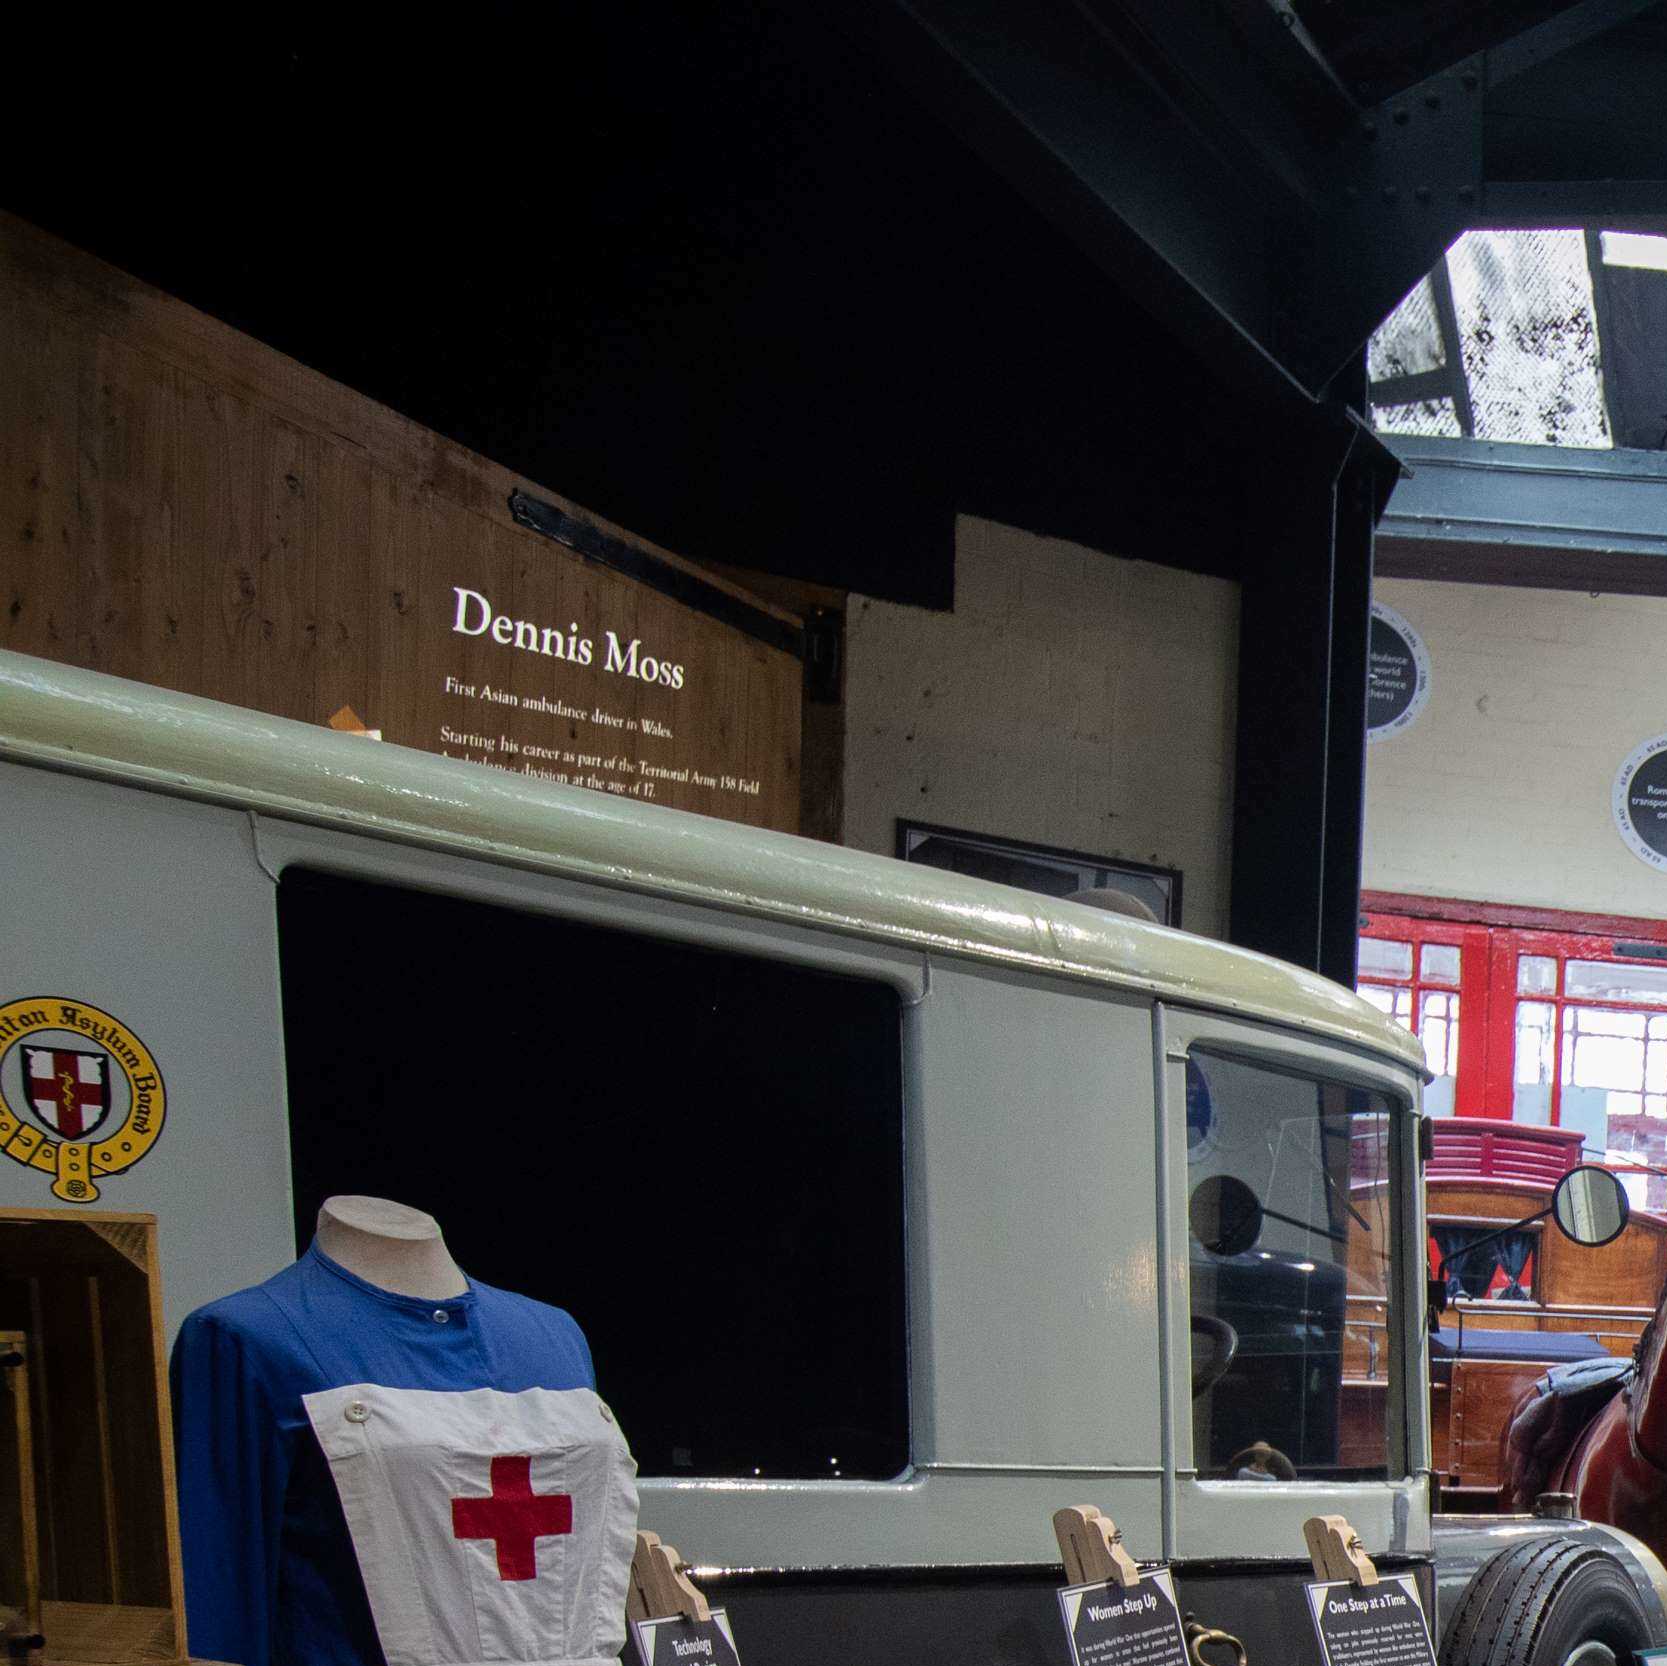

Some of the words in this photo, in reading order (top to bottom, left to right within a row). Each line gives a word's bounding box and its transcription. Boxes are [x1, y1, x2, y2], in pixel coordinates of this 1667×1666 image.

[453, 587, 592, 665] Dennis
[604, 631, 684, 690] Moss
[445, 676, 476, 697] First
[480, 685, 518, 706] Asian
[522, 696, 587, 720] ambulance
[592, 708, 623, 728] driver
[627, 718, 637, 730] in
[642, 719, 673, 739] Wales.
[441, 726, 495, 751] Starting
[501, 735, 518, 753] his
[522, 742, 560, 760] career
[563, 750, 575, 762] as
[577, 753, 601, 769] part
[604, 755, 616, 769] of
[59, 1006, 141, 1069] Asylum
[133, 1073, 156, 1134] Board
[1088, 1605, 1123, 1621] Women
[1124, 1599, 1143, 1614] Step
[1143, 1594, 1157, 1611] Up
[1329, 1600, 1348, 1614] One
[1349, 1598, 1368, 1614] Step
[1370, 1597, 1379, 1609] at
[1383, 1594, 1406, 1606] Time
[672, 1636, 712, 1656] Technology
